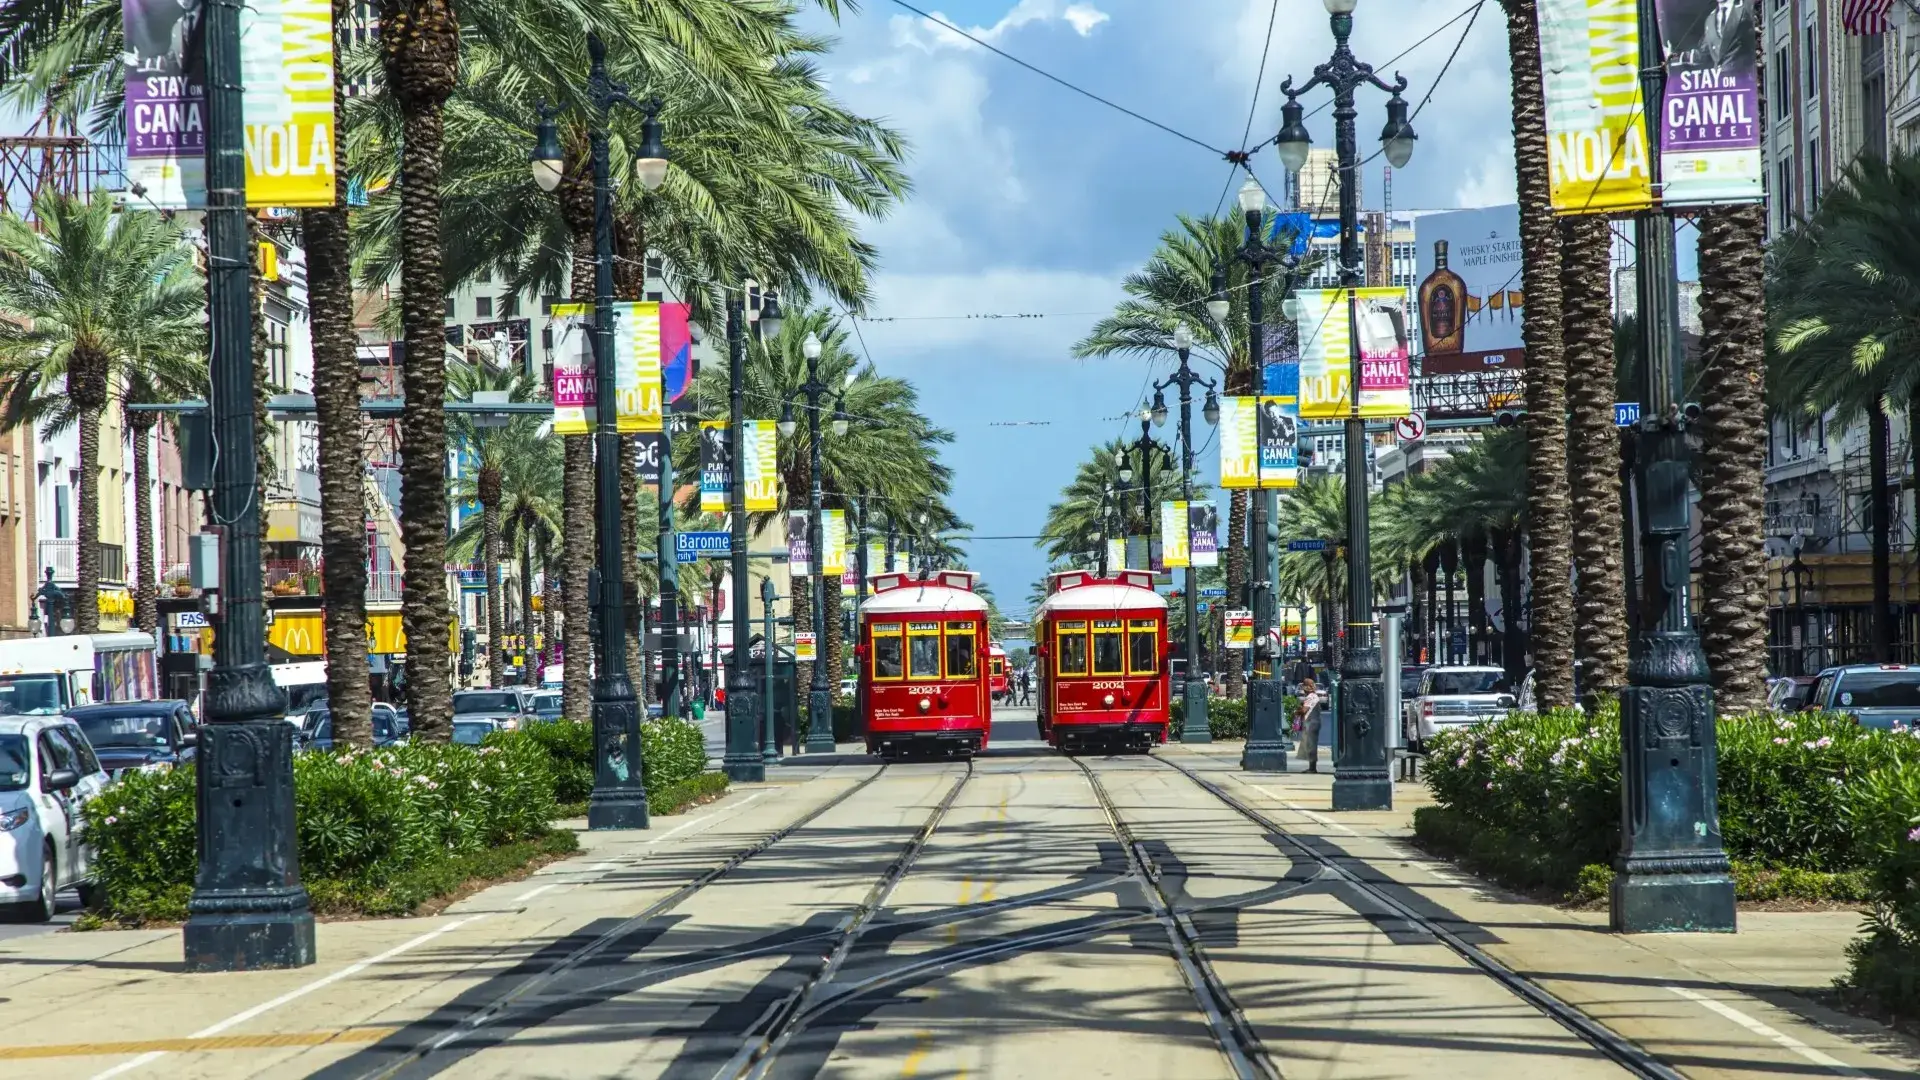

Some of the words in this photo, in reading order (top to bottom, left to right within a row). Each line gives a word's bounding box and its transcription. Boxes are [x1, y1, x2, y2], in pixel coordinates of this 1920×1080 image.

[147, 76, 188, 98] STAY
[190, 85, 203, 95] ON
[1680, 68, 1723, 91] STAY
[1723, 76, 1736, 88] ON
[1668, 93, 1752, 128] CANAL
[134, 104, 203, 134] CANA
[136, 134, 203, 146] STREE
[1669, 125, 1752, 140] STREET
[245, 123, 334, 177] NOLA
[1550, 124, 1650, 186] NOLA
[1460, 245, 1491, 256] WHISKY
[1492, 240, 1522, 254] STARTE
[1463, 257, 1487, 267] MAPLE
[1489, 251, 1522, 265] FINISHED
[1365, 348, 1390, 358] SHOP
[562, 364, 588, 376] SHOP
[1362, 361, 1405, 378] CANAL
[1302, 374, 1349, 405] NOLA
[616, 387, 660, 416] NOLA
[1616, 405, 1640, 423] phi
[1267, 438, 1284, 447] PLAY
[1263, 448, 1294, 459] CANAL
[708, 463, 723, 471] PLAY
[1222, 458, 1256, 478] NOLA
[744, 480, 776, 500] NOLA
[680, 534, 729, 549] Baronne
[1192, 537, 1215, 546] CANAL
[1292, 541, 1325, 550] Burgundy
[677, 552, 691, 561] rsity
[909, 623, 938, 631] CANAL
[908, 686, 942, 695] 2024
[1092, 681, 1125, 690] 2002
